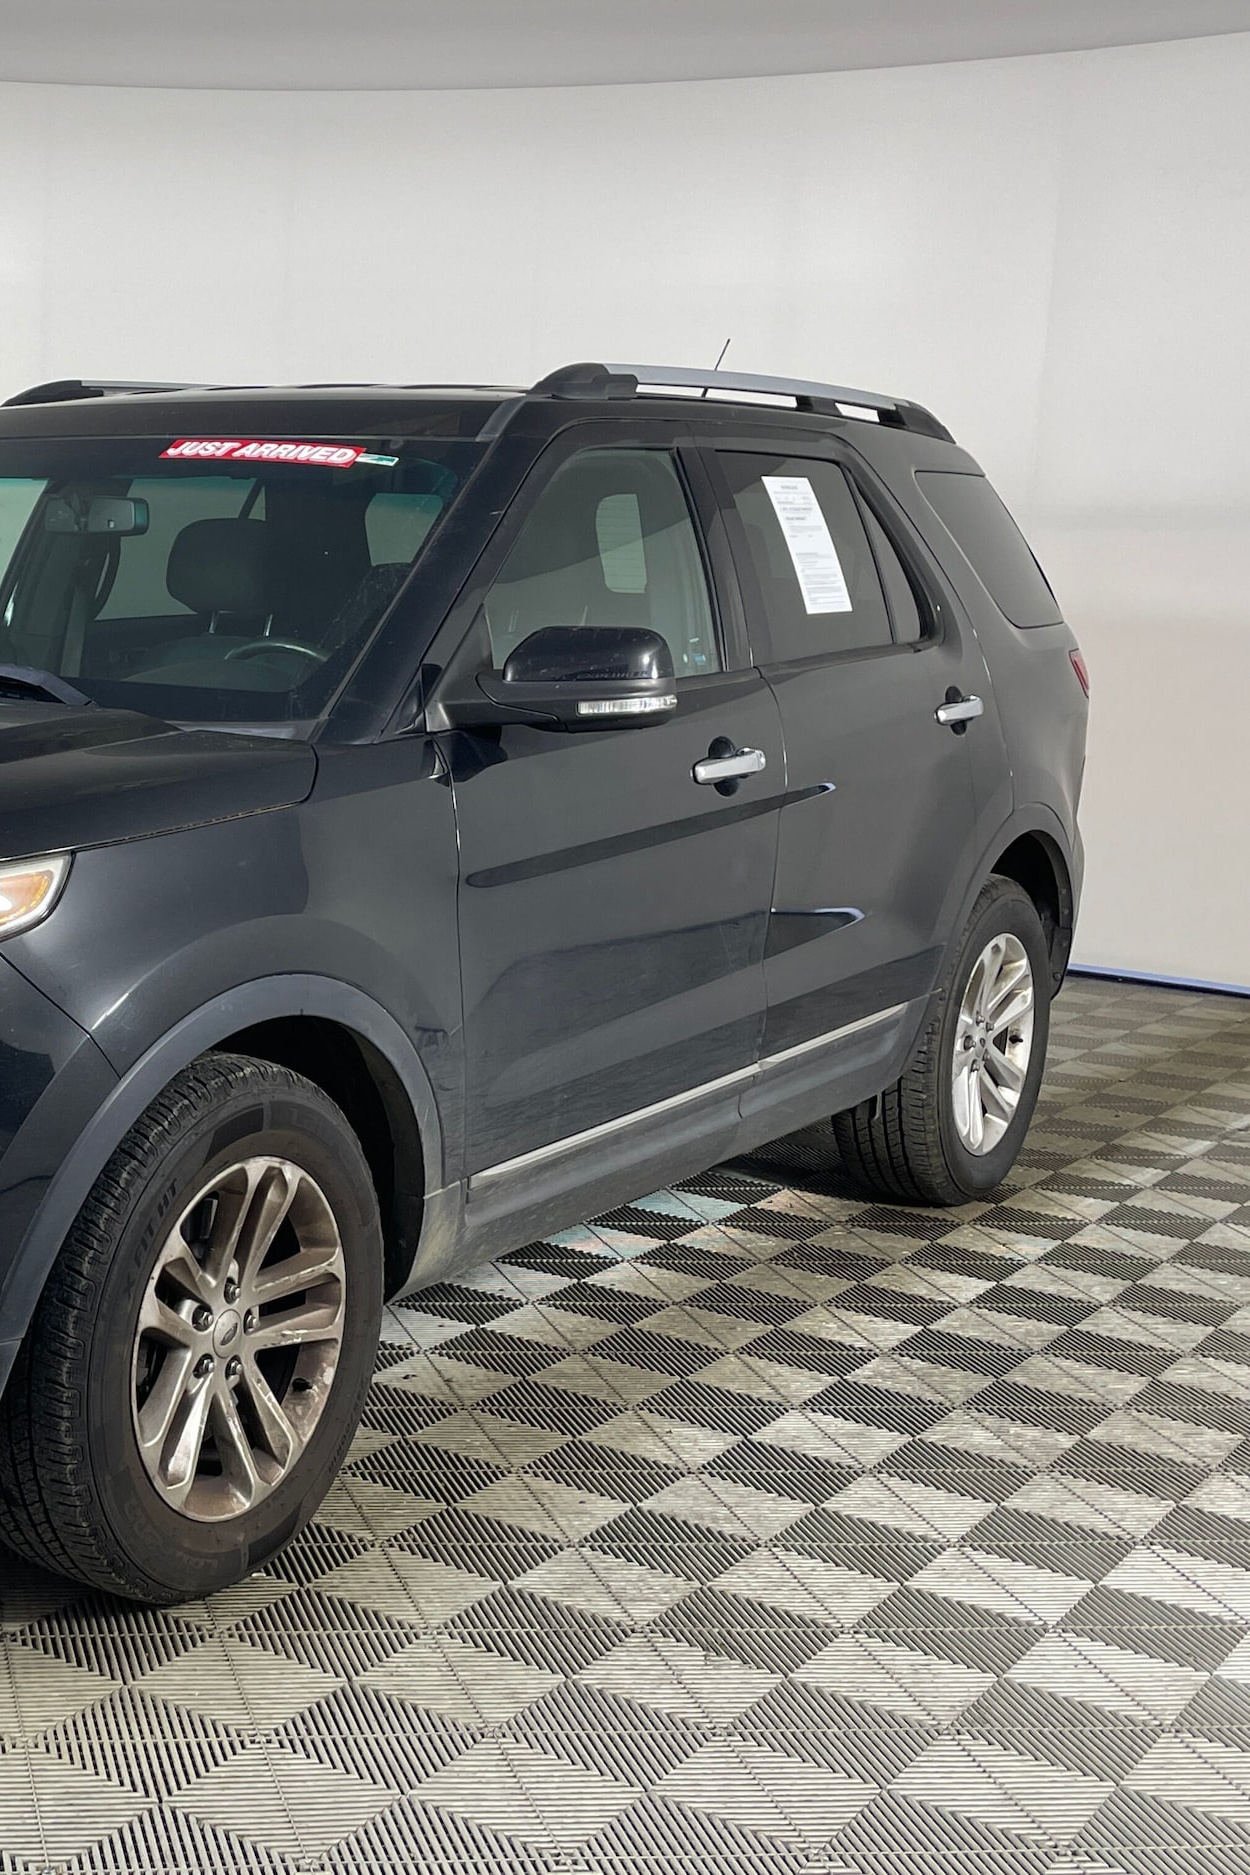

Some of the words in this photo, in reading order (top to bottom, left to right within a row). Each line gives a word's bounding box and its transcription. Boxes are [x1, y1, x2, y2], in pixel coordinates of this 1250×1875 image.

[166, 441, 240, 457] JUST
[232, 442, 358, 464] ARRIVED
[133, 1217, 155, 1269] FIT
[157, 1177, 178, 1219] HT
